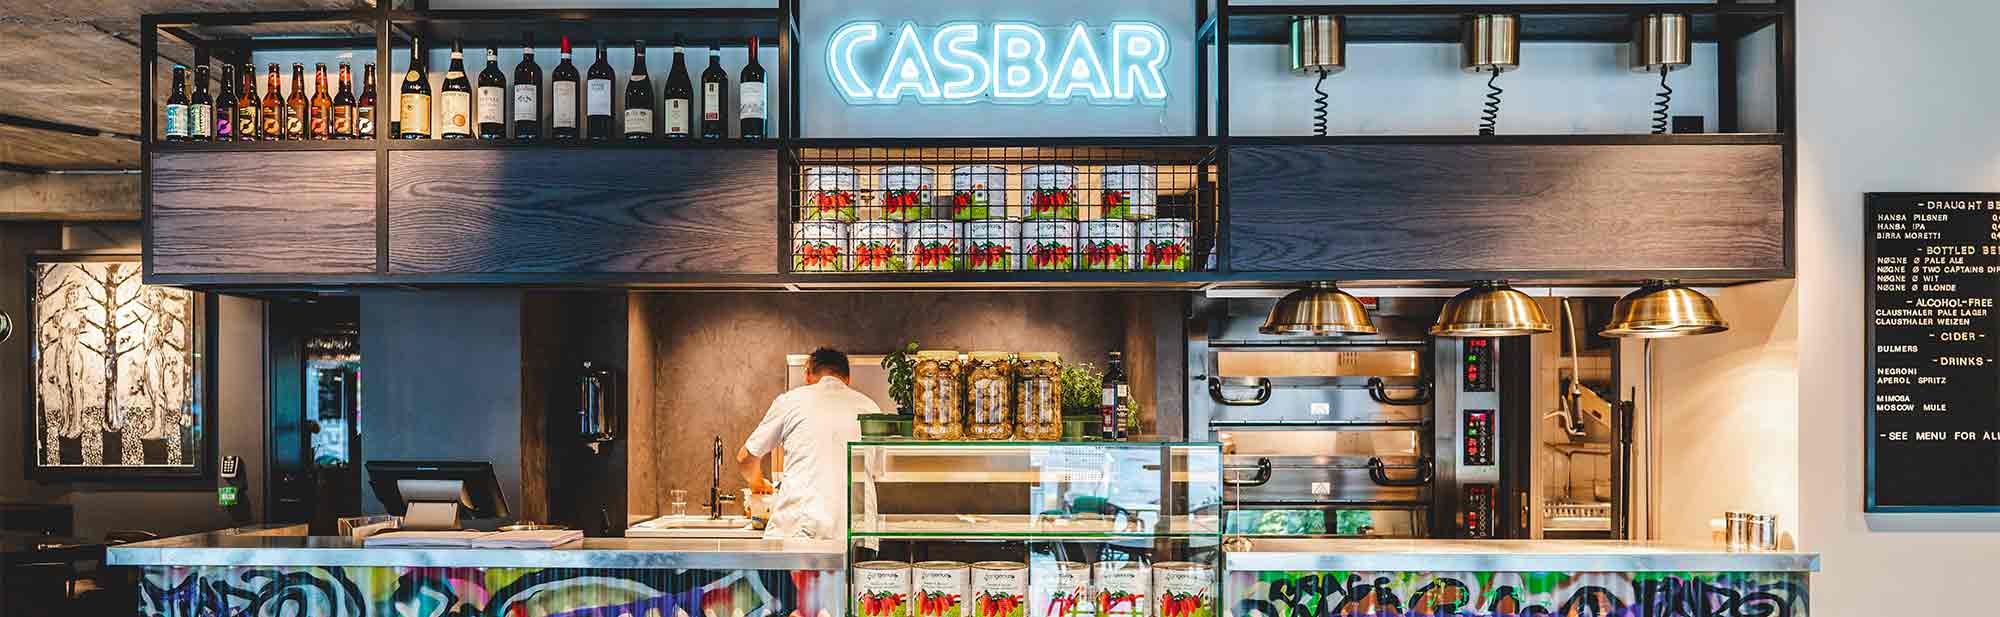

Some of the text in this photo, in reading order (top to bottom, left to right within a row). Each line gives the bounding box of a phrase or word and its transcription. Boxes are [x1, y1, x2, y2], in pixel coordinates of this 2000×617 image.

[830, 24, 1167, 98] CASBAR
[1928, 201, 1982, 210] DRAUGHT
[1927, 246, 1975, 255] BOTTLED
[1916, 298, 1992, 308] ALCOHOL-FREE
[1937, 318, 1970, 326] WEIZEN
[1941, 332, 1975, 341] CIDER
[1940, 357, 1983, 367] DRINKS
[1916, 432, 1946, 440] MENU
[1954, 432, 1976, 440] FOR
